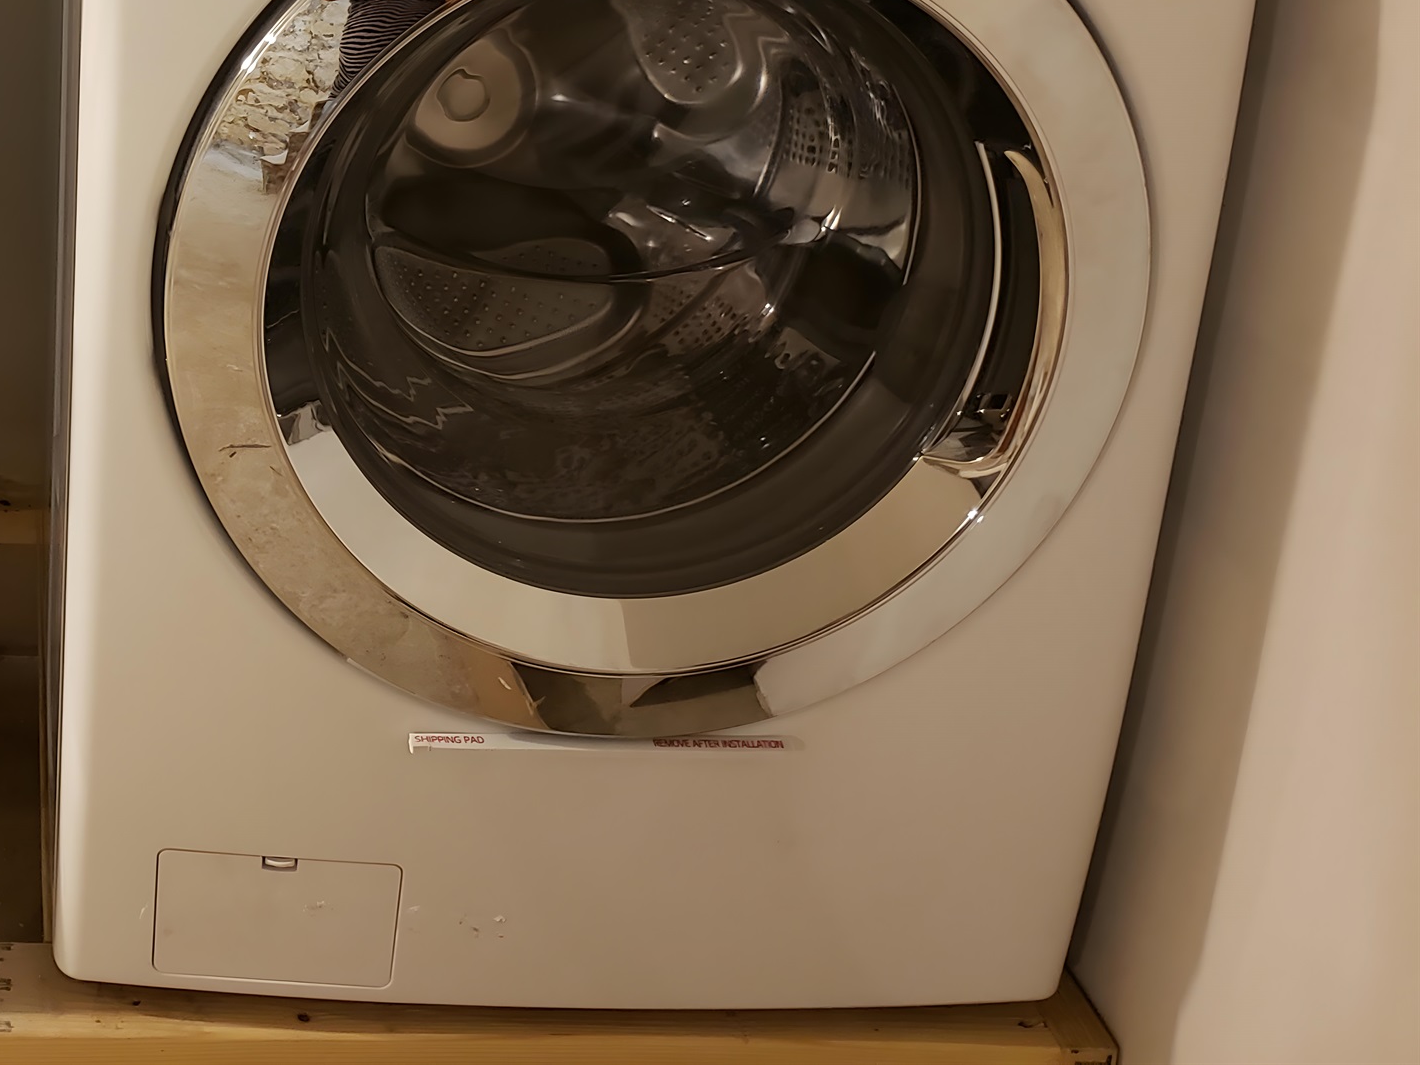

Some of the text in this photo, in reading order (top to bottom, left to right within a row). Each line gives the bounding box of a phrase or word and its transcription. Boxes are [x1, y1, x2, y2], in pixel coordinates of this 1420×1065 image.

[414, 735, 485, 744] SHIPPING PAD
[653, 738, 784, 749] REMOVE AFTER INSTALLATION
